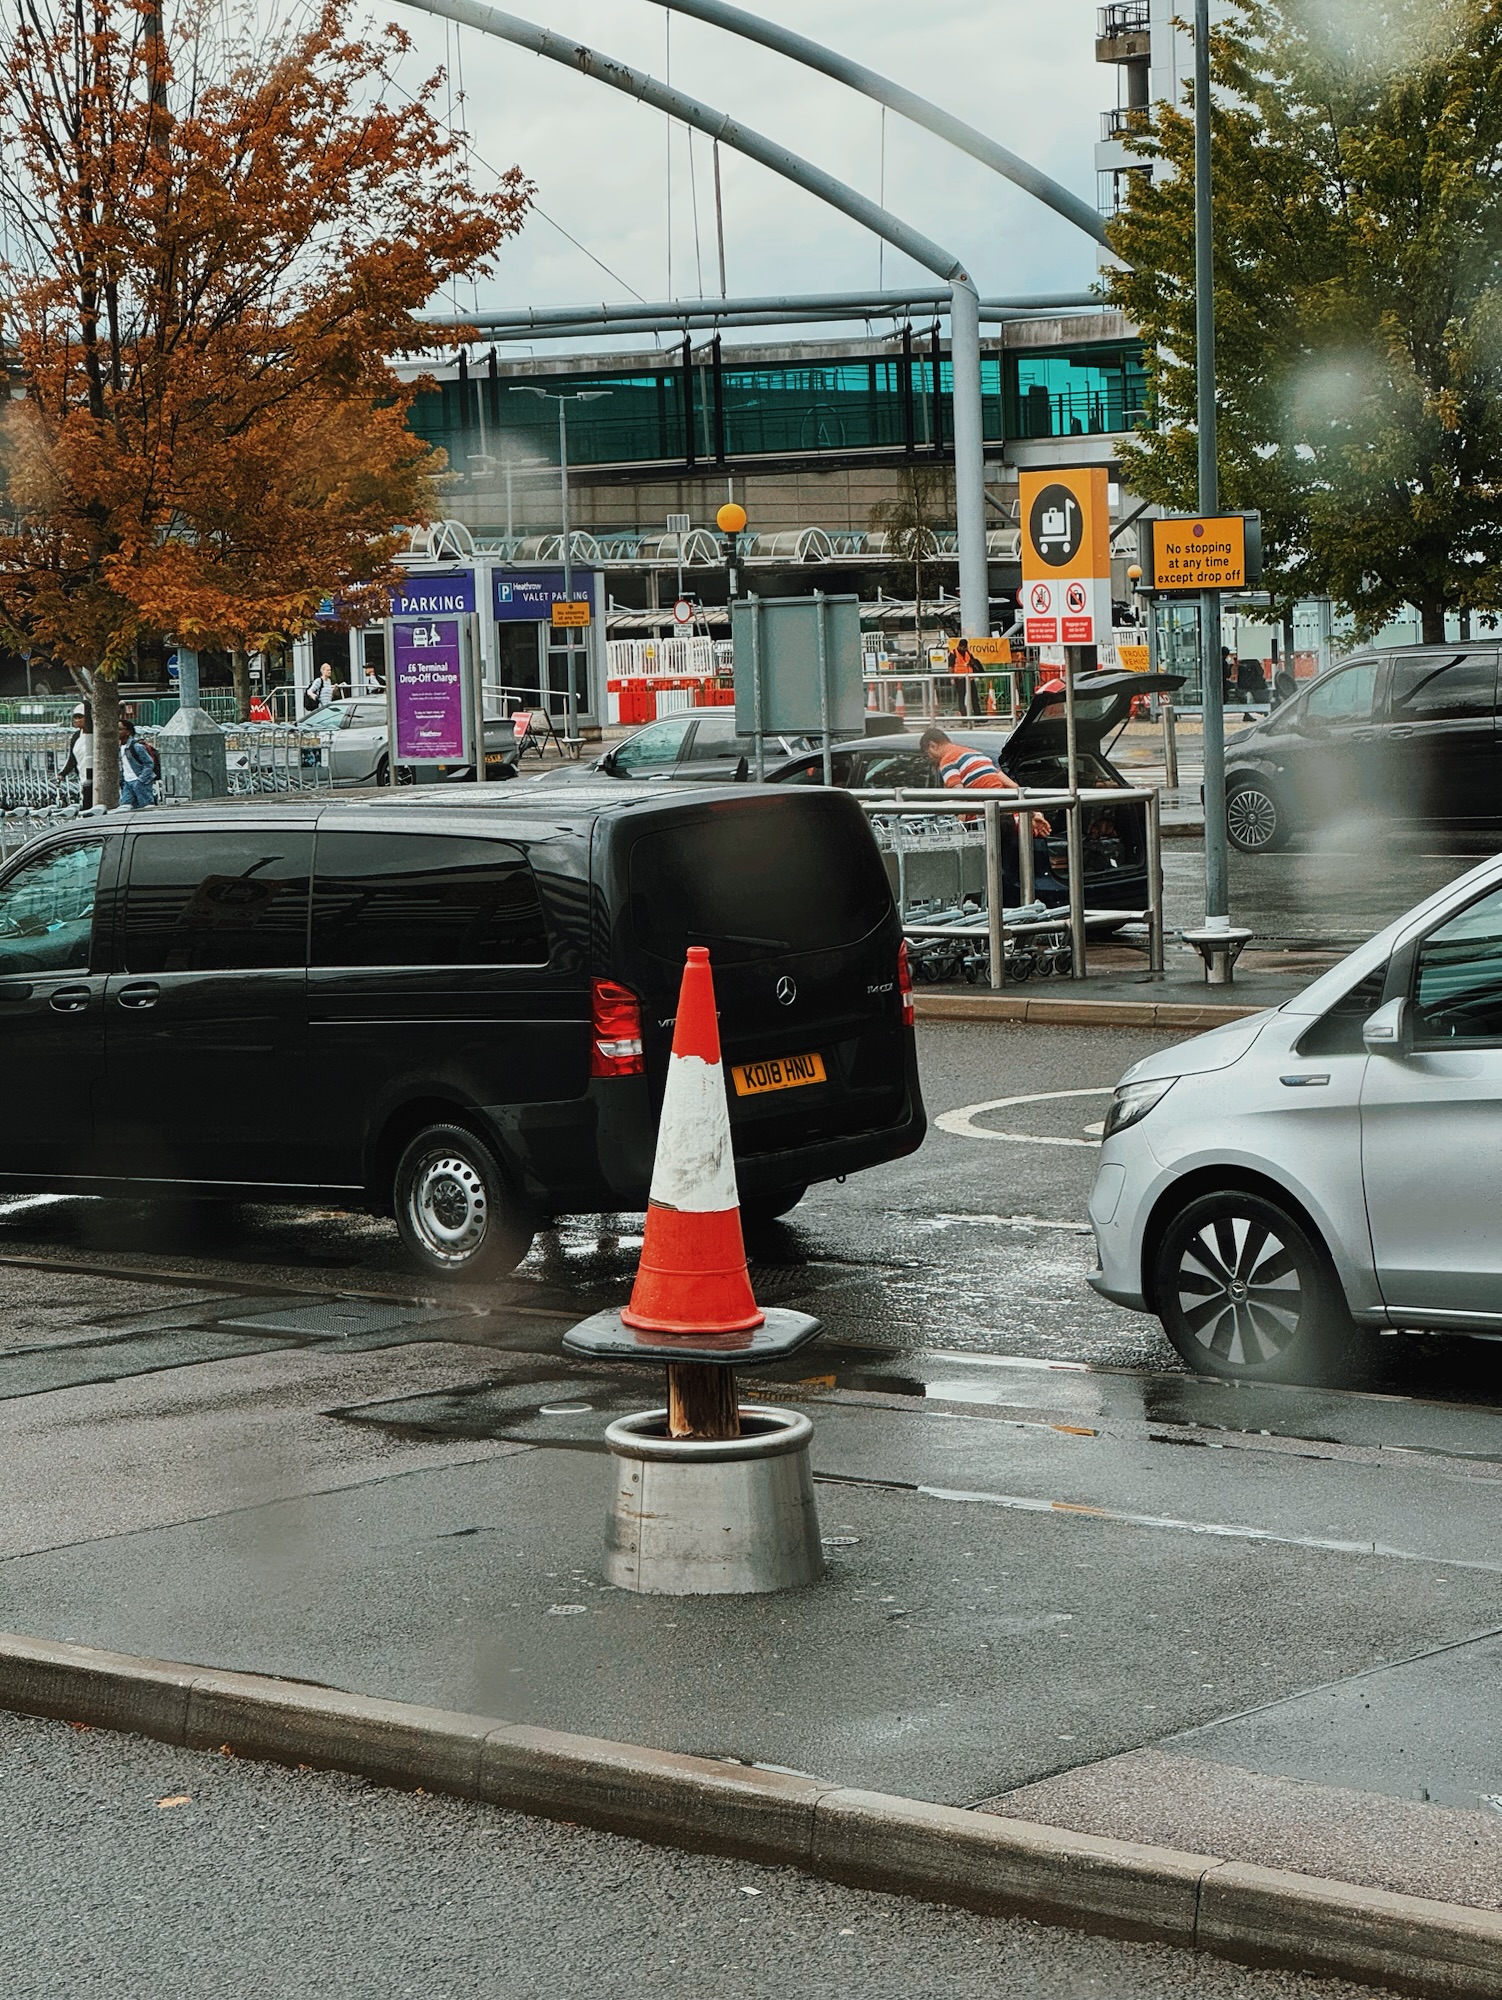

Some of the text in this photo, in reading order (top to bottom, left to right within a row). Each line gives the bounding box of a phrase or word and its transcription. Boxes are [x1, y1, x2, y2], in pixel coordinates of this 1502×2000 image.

[1166, 541, 1231, 554] No stopping
[1168, 556, 1229, 569] at any time
[1158, 569, 1241, 584] except drop off
[513, 582, 542, 591] Heathrow
[523, 591, 588, 602] VALET PARING
[401, 595, 465, 612] PARKING
[969, 642, 999, 653] rrovial
[408, 662, 448, 673] £6 Terminal
[1123, 657, 1150, 665] VEHICL
[400, 672, 457, 685] Drop-Off Charge
[783, 1055, 815, 1082] HNU
